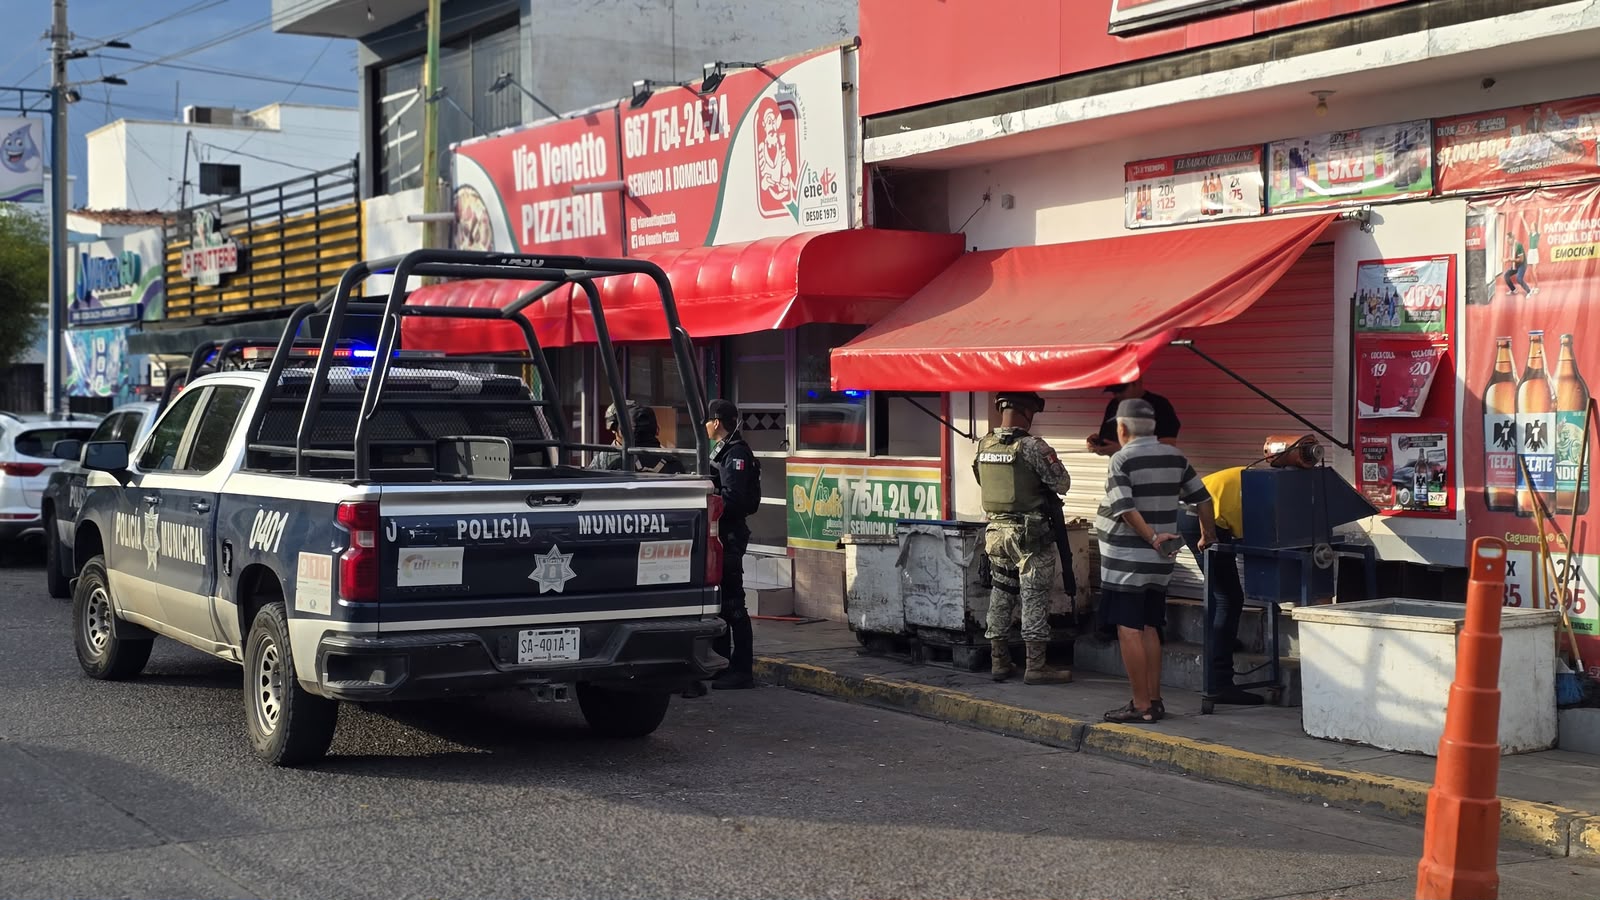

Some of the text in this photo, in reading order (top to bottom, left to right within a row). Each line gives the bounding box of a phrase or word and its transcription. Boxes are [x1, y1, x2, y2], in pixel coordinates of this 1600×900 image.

[624, 113, 649, 159] 667
[652, 93, 731, 154] 754-24-24
[512, 132, 607, 192] Via Venetto
[1176, 160, 1185, 170] EL
[1186, 157, 1208, 169] SABOR
[1208, 155, 1222, 167] QUE
[628, 158, 718, 198] SERVICIO A DOMICILIO
[805, 208, 837, 222] DESDE 1979
[1547, 232, 1580, 246] OFICIAL
[1580, 231, 1594, 243] DE
[182, 247, 237, 274] LA FRUTTERIA
[1403, 285, 1442, 308] 40%
[1409, 361, 1431, 376] $20
[979, 452, 1013, 463] EJÉRCITO
[1525, 456, 1553, 473] ECATE
[851, 482, 938, 520] 754.24.24
[249, 508, 289, 553] 0401
[457, 514, 531, 540] POLICÍA
[578, 513, 670, 535] MUNICIPAL
[851, 521, 894, 536] SERVICIO A
[115, 507, 206, 566] POLICÍA MUNICIPAL
[644, 544, 686, 559] 911
[300, 558, 328, 578] 911
[521, 637, 577, 654] SA-401A-1
